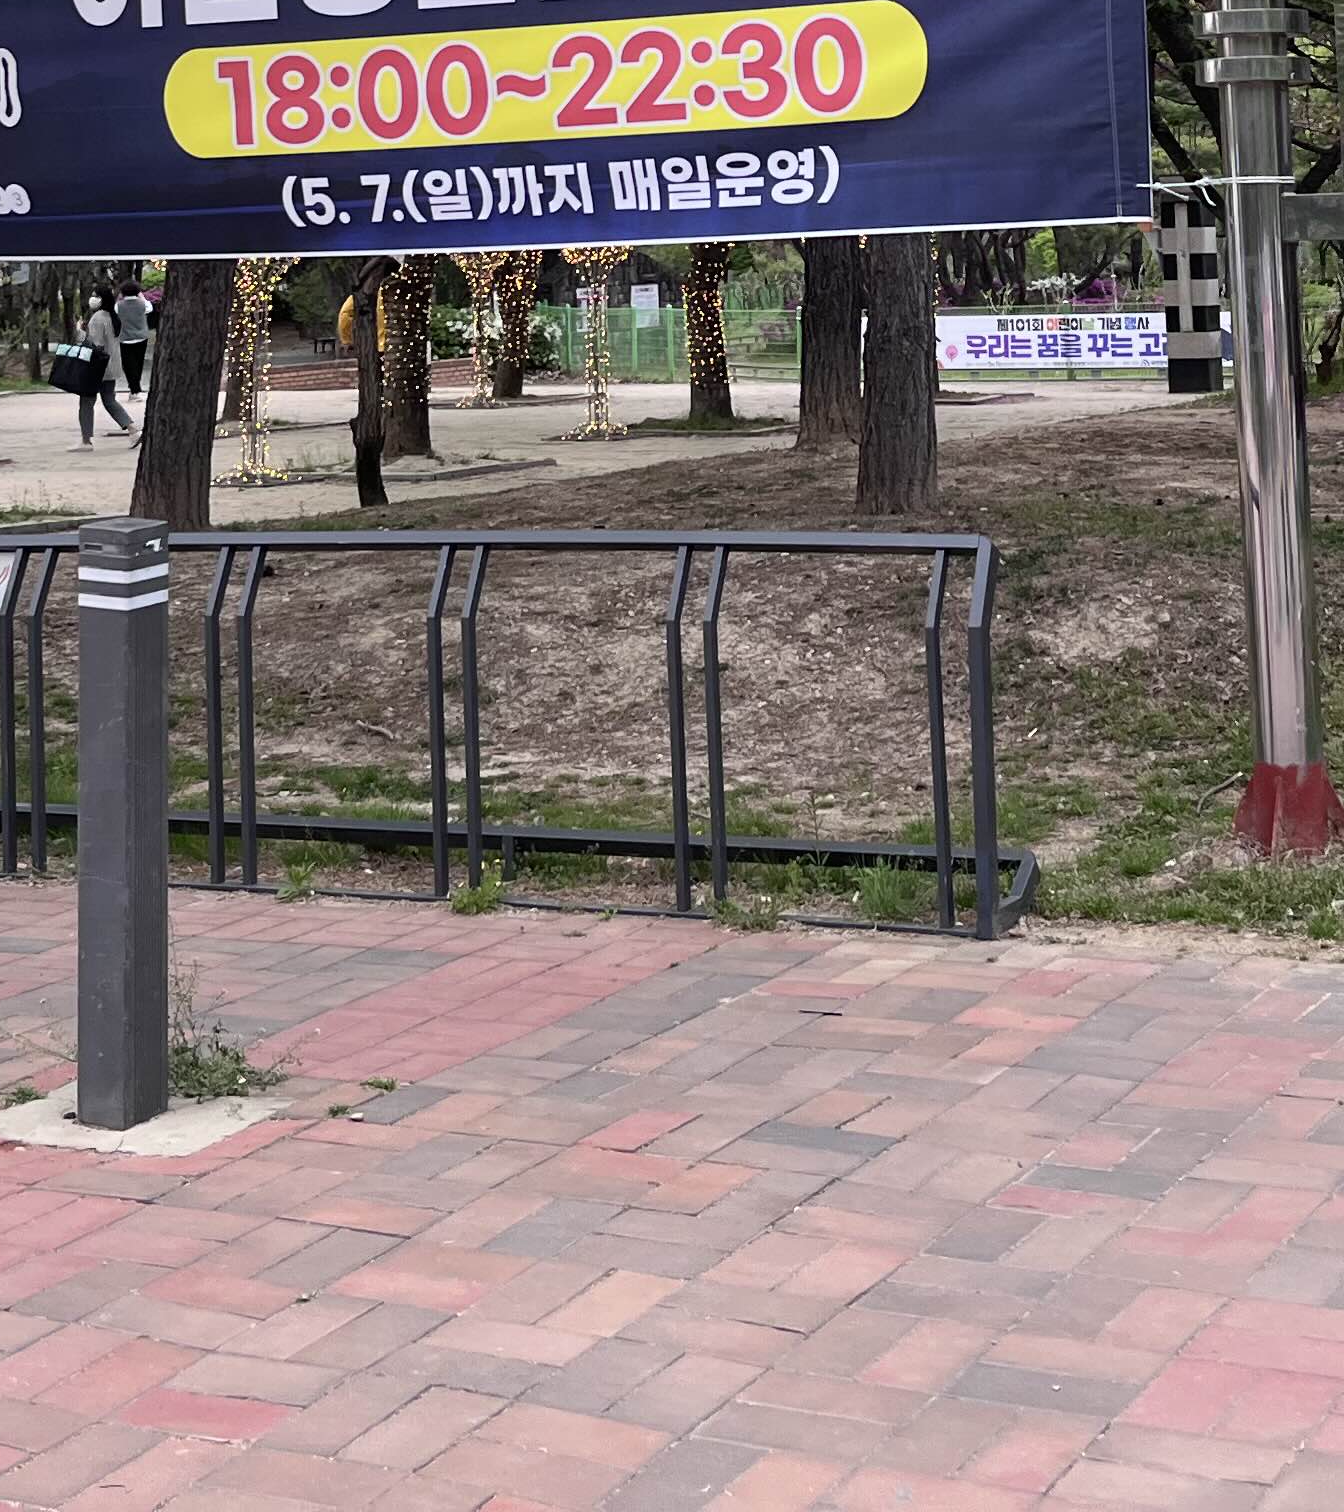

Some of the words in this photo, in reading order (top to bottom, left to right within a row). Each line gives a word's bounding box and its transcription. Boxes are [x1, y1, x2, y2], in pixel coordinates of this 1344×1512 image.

[216, 13, 865, 150] 18:00~22:30
[609, 145, 841, 215] 매일운영)
[966, 334, 1033, 360] 우리는
[1037, 333, 1083, 359] 꿈을
[1087, 333, 1134, 358] 꾸는
[997, 317, 1044, 332] 제101회
[1097, 317, 1122, 331] 기념
